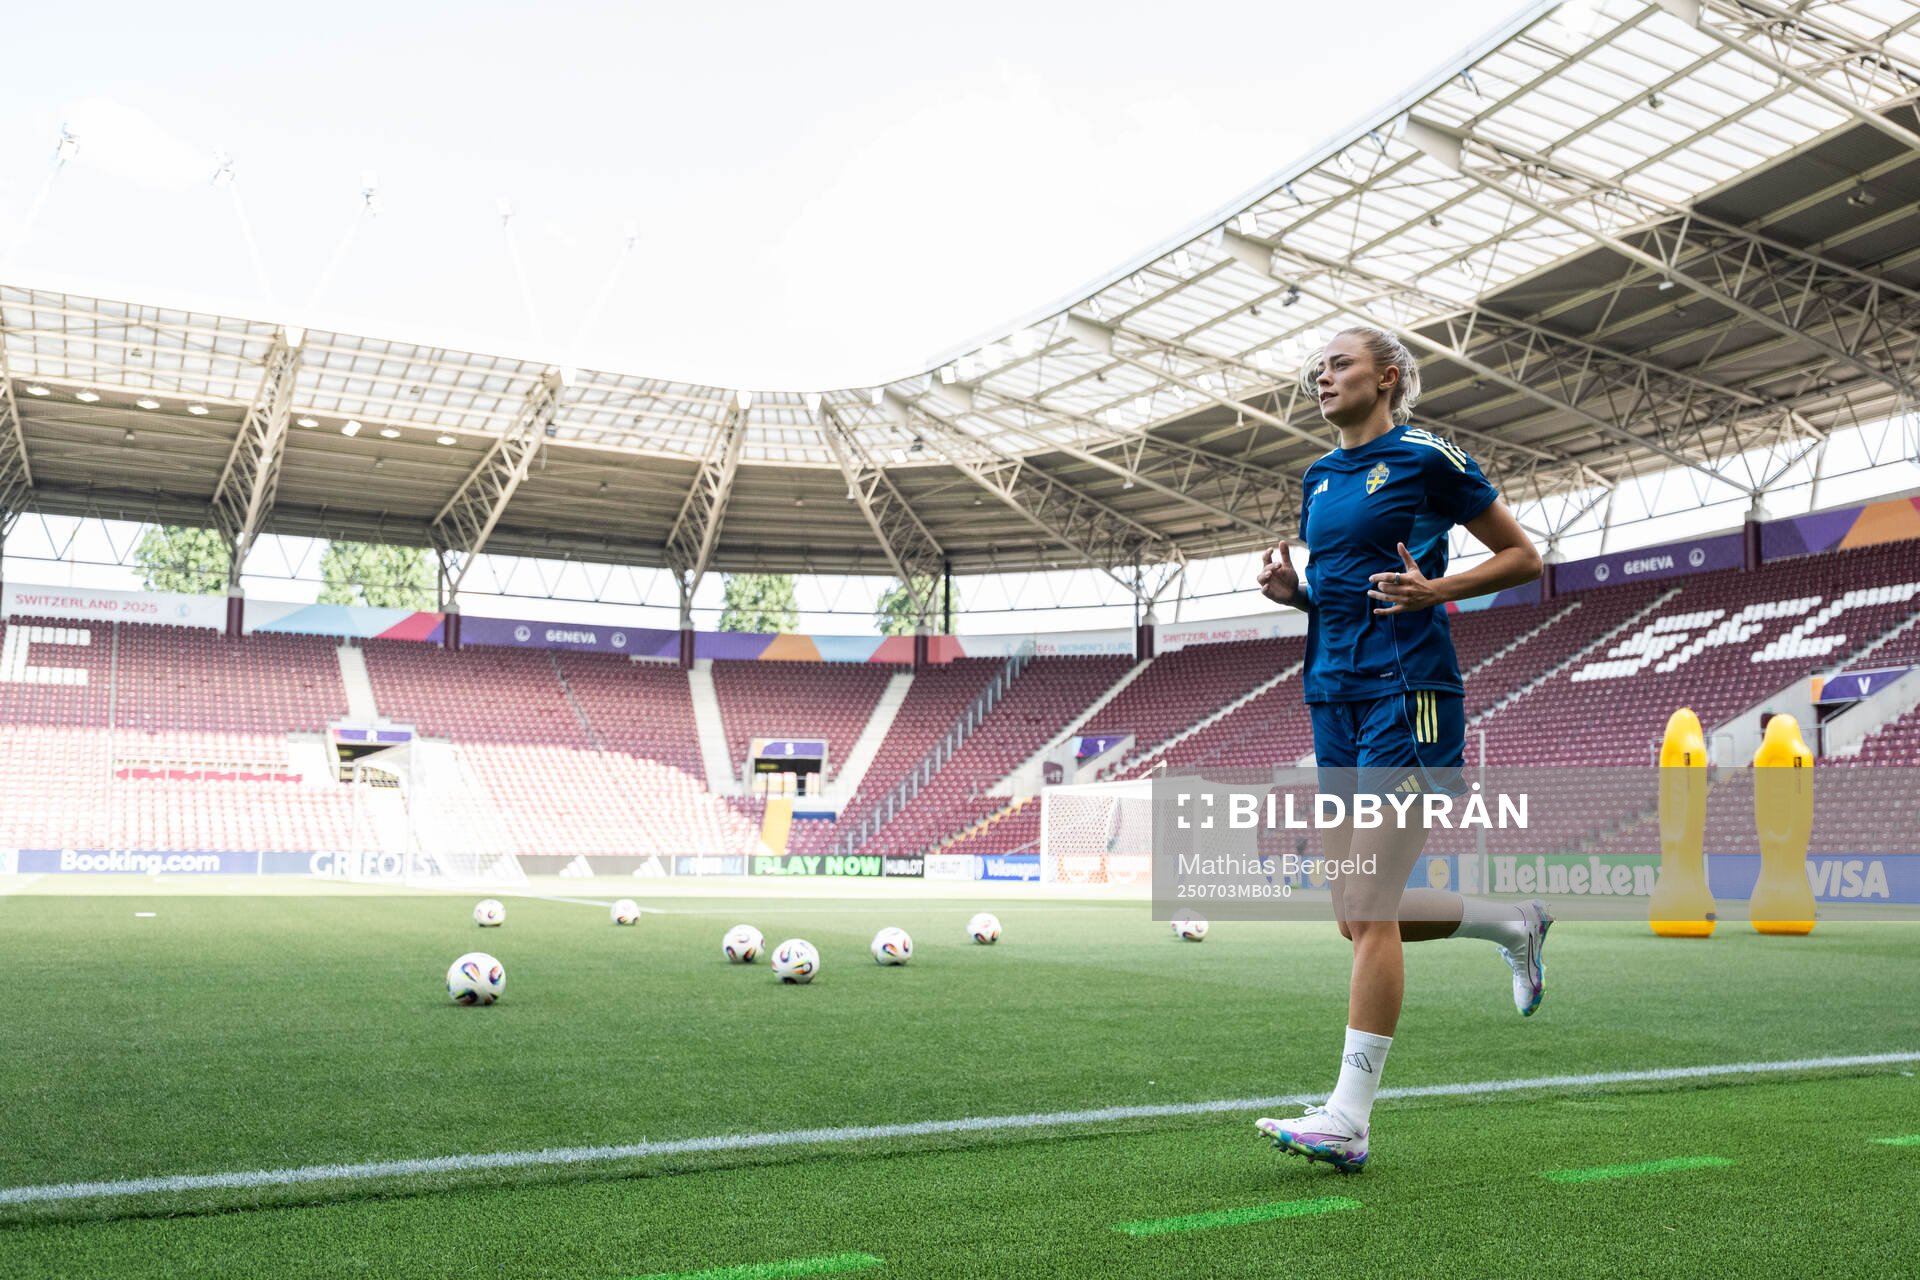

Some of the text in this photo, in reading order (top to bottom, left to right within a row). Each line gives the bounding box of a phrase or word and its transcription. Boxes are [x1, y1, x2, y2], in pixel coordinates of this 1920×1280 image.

[1623, 555, 1674, 575] GENEVA
[15, 593, 158, 614] SWITZERLAND 2025
[545, 629, 598, 645] GENEVA
[1162, 628, 1259, 644] SWITZERLAND 2025
[1858, 676, 1871, 695] V
[60, 849, 220, 876] Booking.com
[309, 850, 431, 877] GRFOS
[755, 855, 821, 875] PLAY
[825, 855, 881, 875] NOW
[1493, 855, 1655, 896] Heineken
[1805, 860, 1890, 898] VISA
